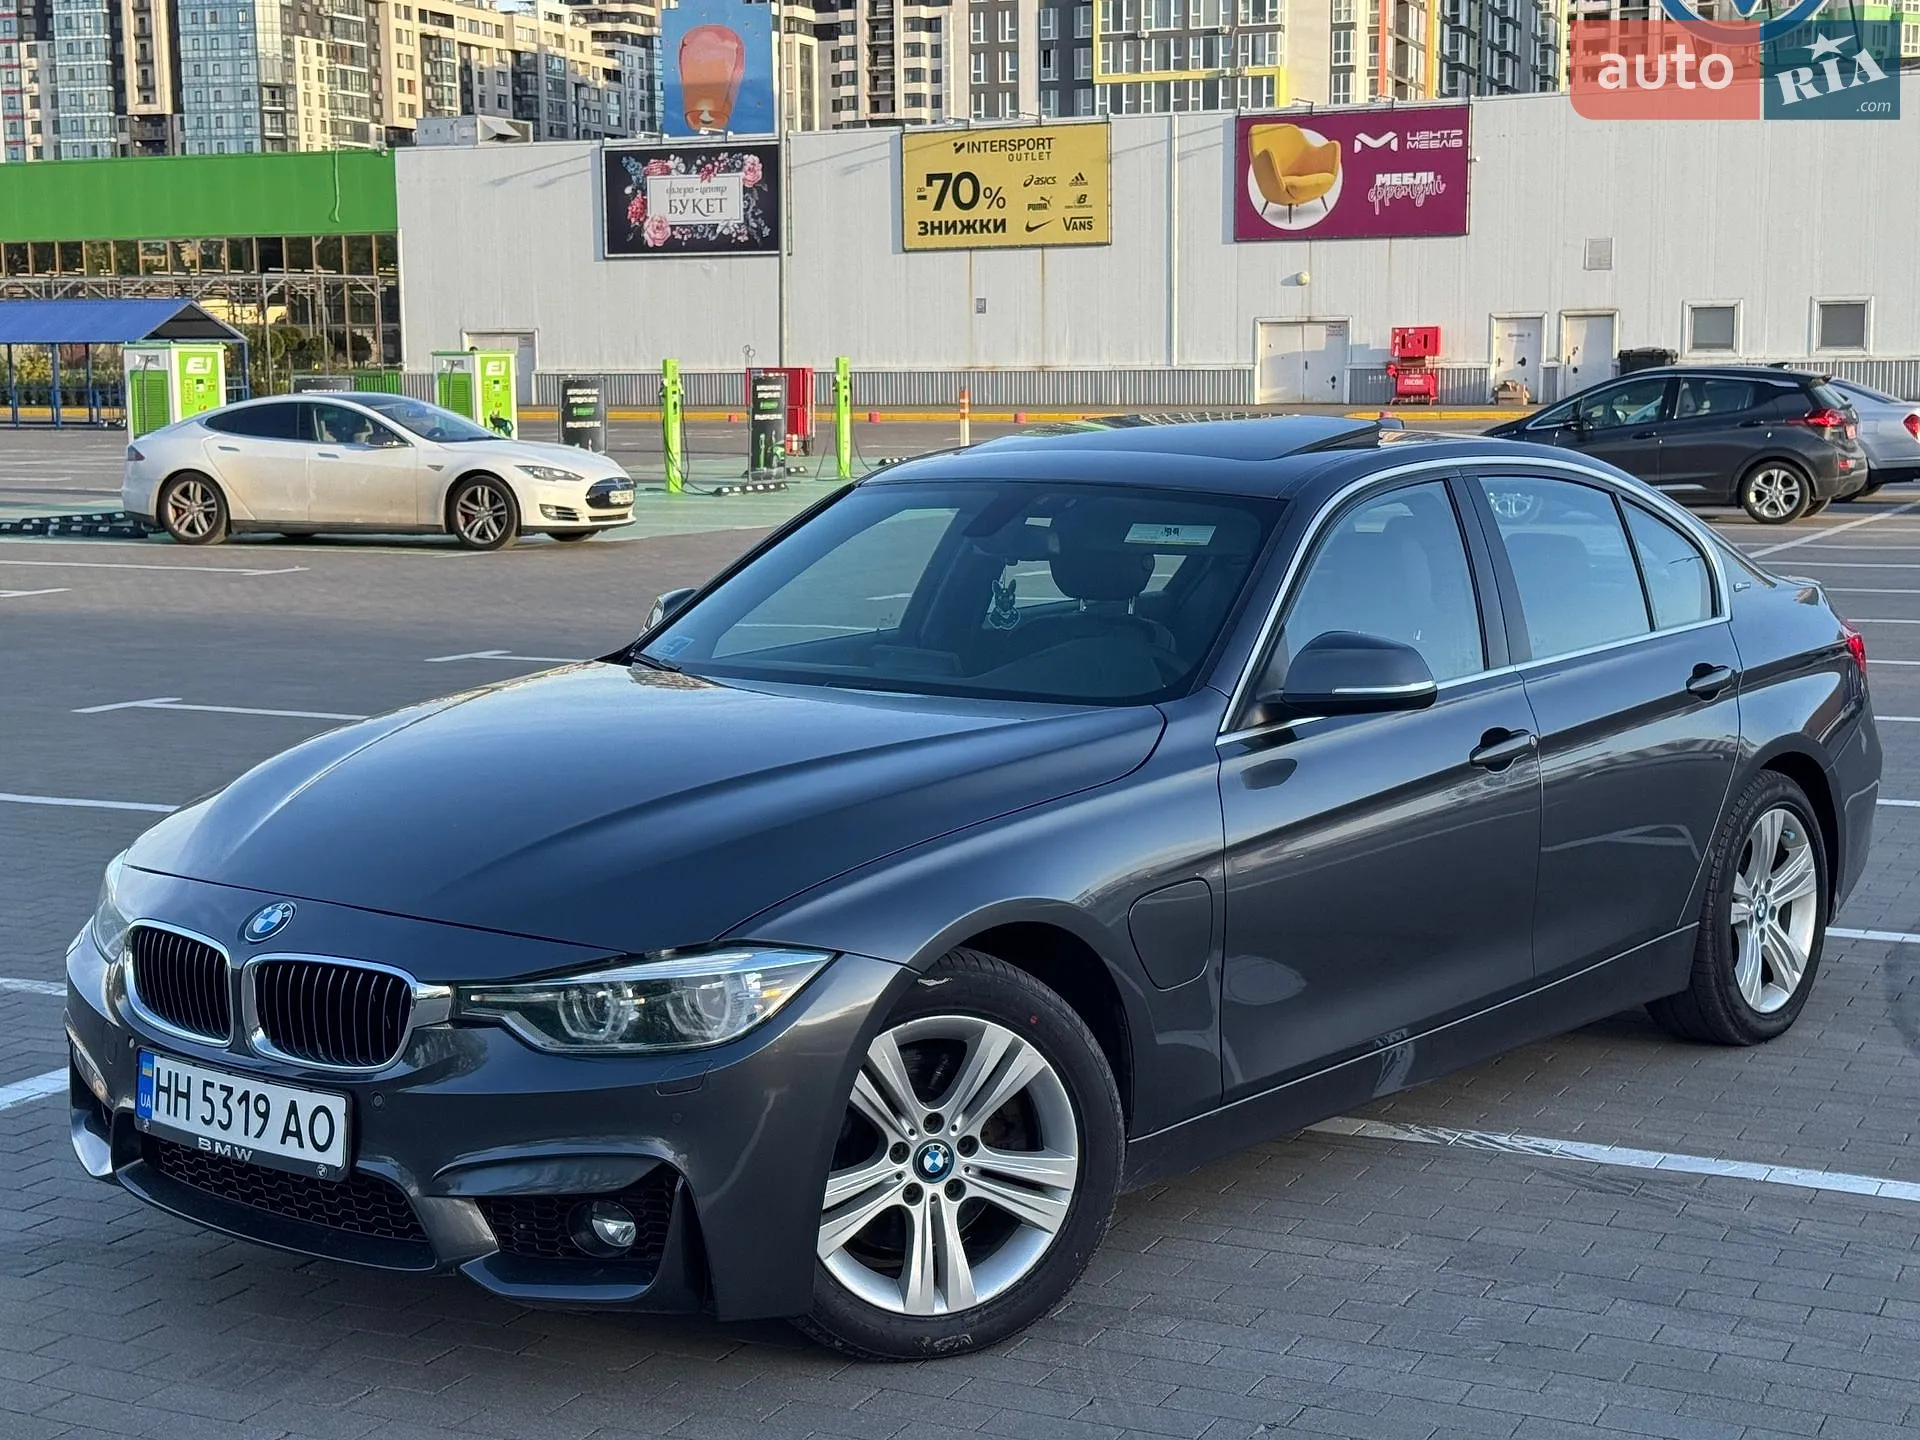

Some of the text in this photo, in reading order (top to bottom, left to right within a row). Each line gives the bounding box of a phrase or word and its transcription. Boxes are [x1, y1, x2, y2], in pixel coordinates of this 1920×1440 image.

[966, 137, 1054, 154] INTERSPORT
[1008, 151, 1052, 162] OUTLET
[668, 198, 728, 217] БУКЕТ
[917, 218, 1007, 236] ЗНИЖКИ
[141, 1092, 151, 1109] UA
[201, 1080, 271, 1139] 5319
[198, 1137, 253, 1162] BMW
